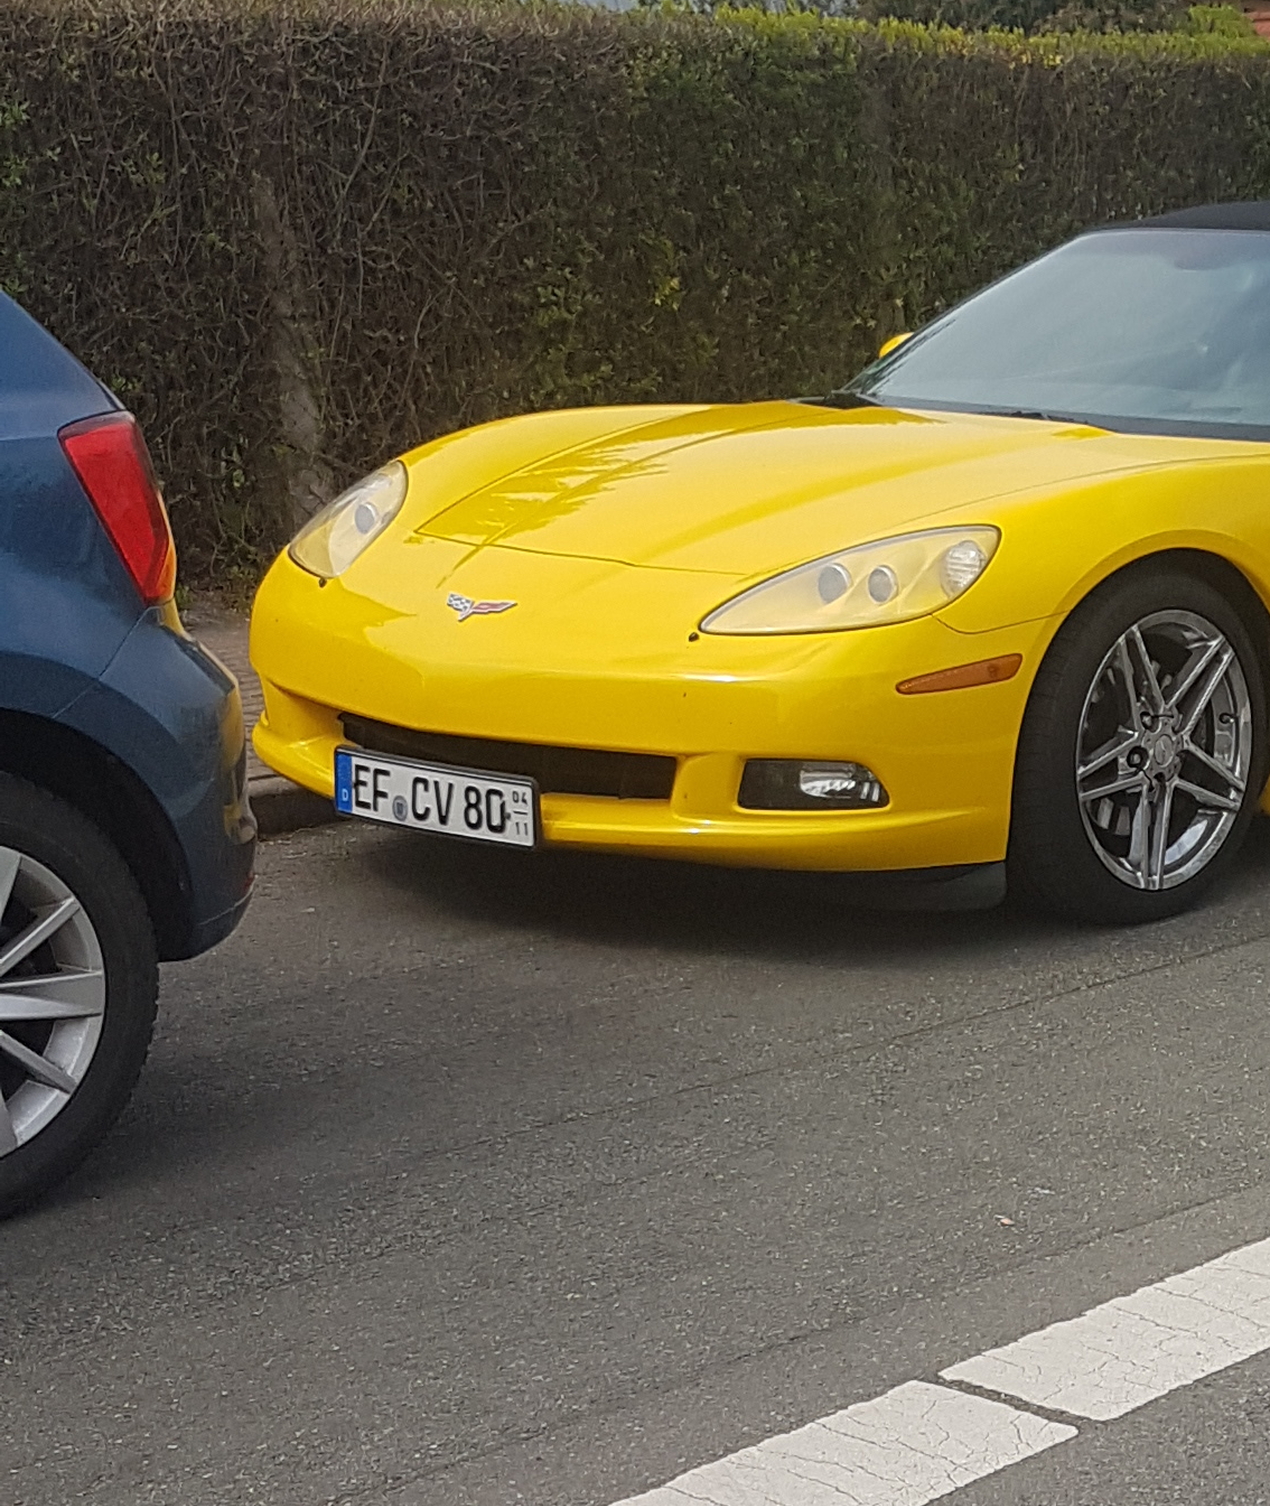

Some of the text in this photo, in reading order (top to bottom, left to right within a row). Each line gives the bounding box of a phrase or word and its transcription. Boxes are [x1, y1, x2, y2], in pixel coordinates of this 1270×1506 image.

[342, 788, 349, 802] D
[353, 763, 508, 834] EF CV 80
[512, 790, 528, 806] 04
[515, 821, 528, 836] 11
